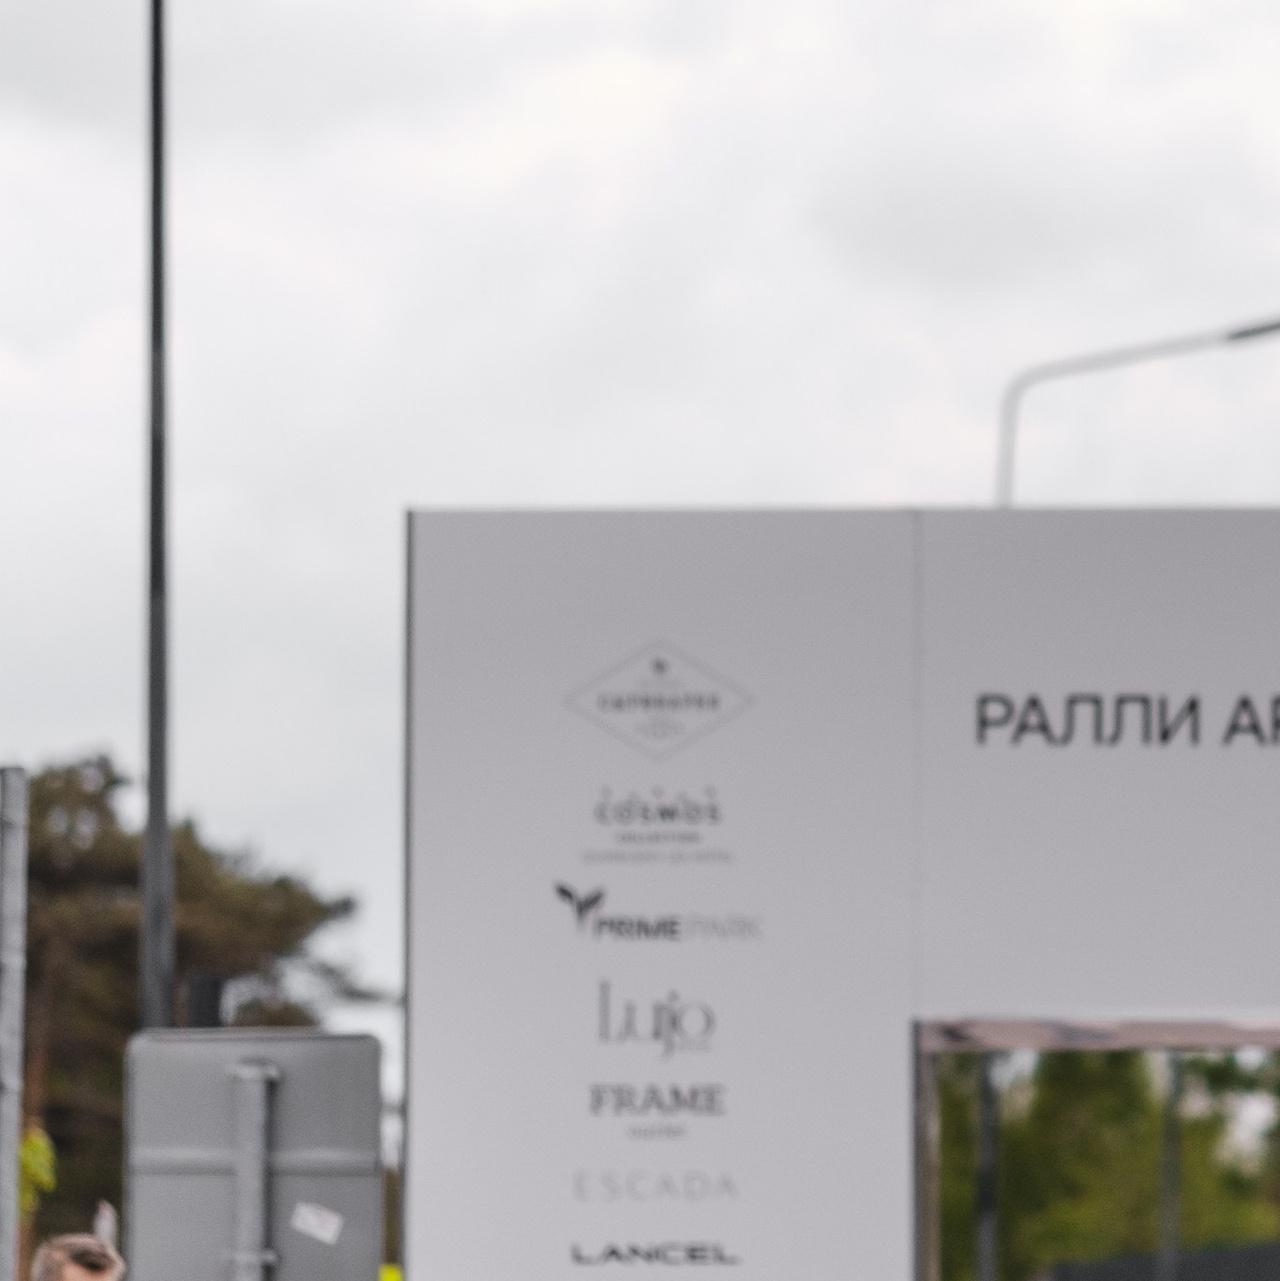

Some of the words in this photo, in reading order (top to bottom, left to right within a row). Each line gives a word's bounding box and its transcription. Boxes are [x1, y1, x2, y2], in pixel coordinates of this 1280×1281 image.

[976, 692, 1201, 748] РАЛЛИ
[589, 1083, 726, 1116] FRAME
[572, 1168, 741, 1203] ESCADA
[570, 1241, 740, 1266] LANCEL
